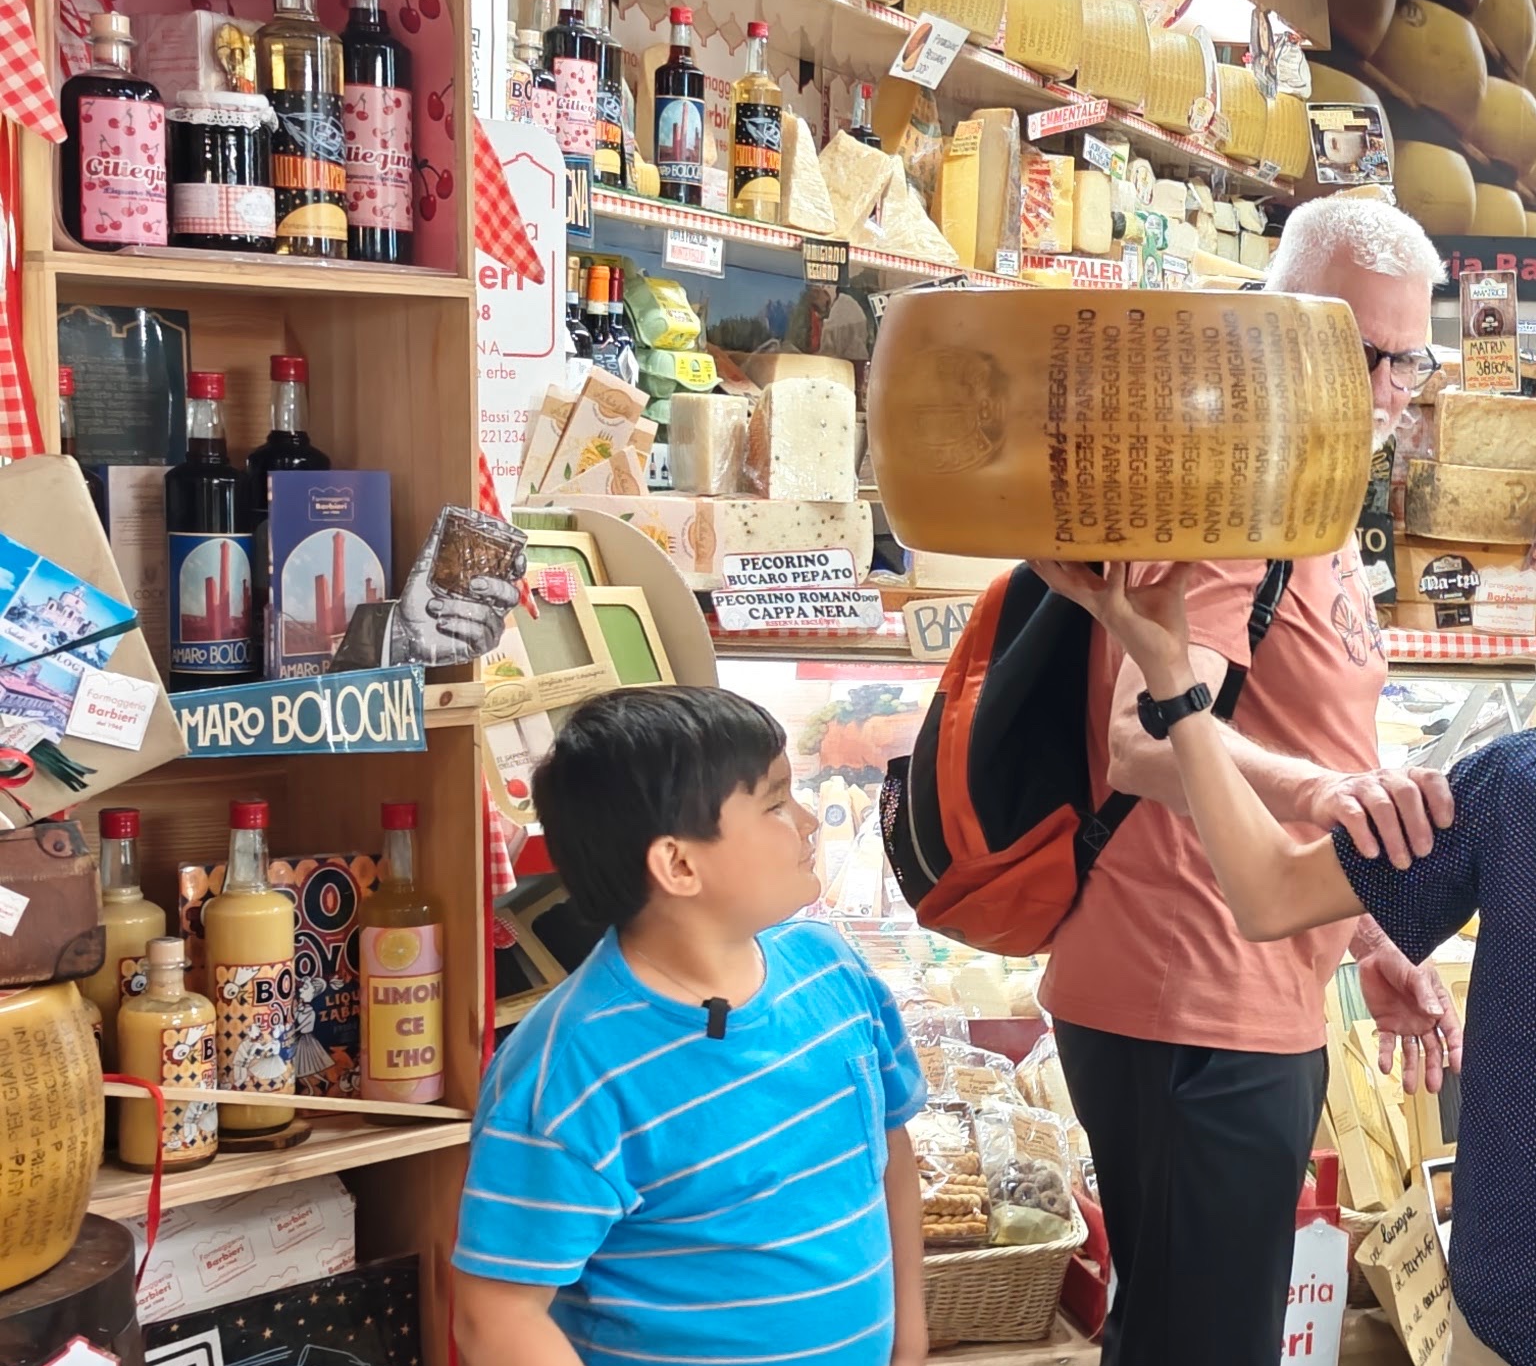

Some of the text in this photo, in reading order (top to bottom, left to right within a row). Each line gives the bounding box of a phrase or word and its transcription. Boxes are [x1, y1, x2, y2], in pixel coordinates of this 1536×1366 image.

[556, 96, 597, 114] Cilieg
[1039, 99, 1107, 128] EMMENTALER
[345, 144, 414, 172] liegina
[85, 156, 167, 188] Ciliegin
[1022, 254, 1123, 282] MMENTALER
[486, 363, 516, 380] erbe
[1101, 325, 1121, 423] REGGIANO
[481, 410, 529, 423] Bassi 25
[1127, 308, 1148, 529] PARMIGIANO REGGIANO
[481, 430, 527, 443] 221234
[1153, 326, 1174, 543] REGGIANO PARMIGIANO
[740, 553, 830, 572] PECORINO
[727, 568, 853, 586] BUCARO PEPATO
[715, 590, 880, 607] PECORINO ROMANO DOP
[749, 604, 861, 621] CAPPA NERA
[86, 688, 147, 712] Formaggeria
[271, 678, 419, 745] BOLOGNA
[87, 703, 139, 725] Barbieri
[254, 966, 294, 1005] BO
[372, 981, 441, 1006] LIMON
[395, 1016, 425, 1037] CE
[386, 1046, 436, 1069] L'HO
[276, 1207, 313, 1233] Barbieri
[205, 1244, 245, 1271] Barbieri
